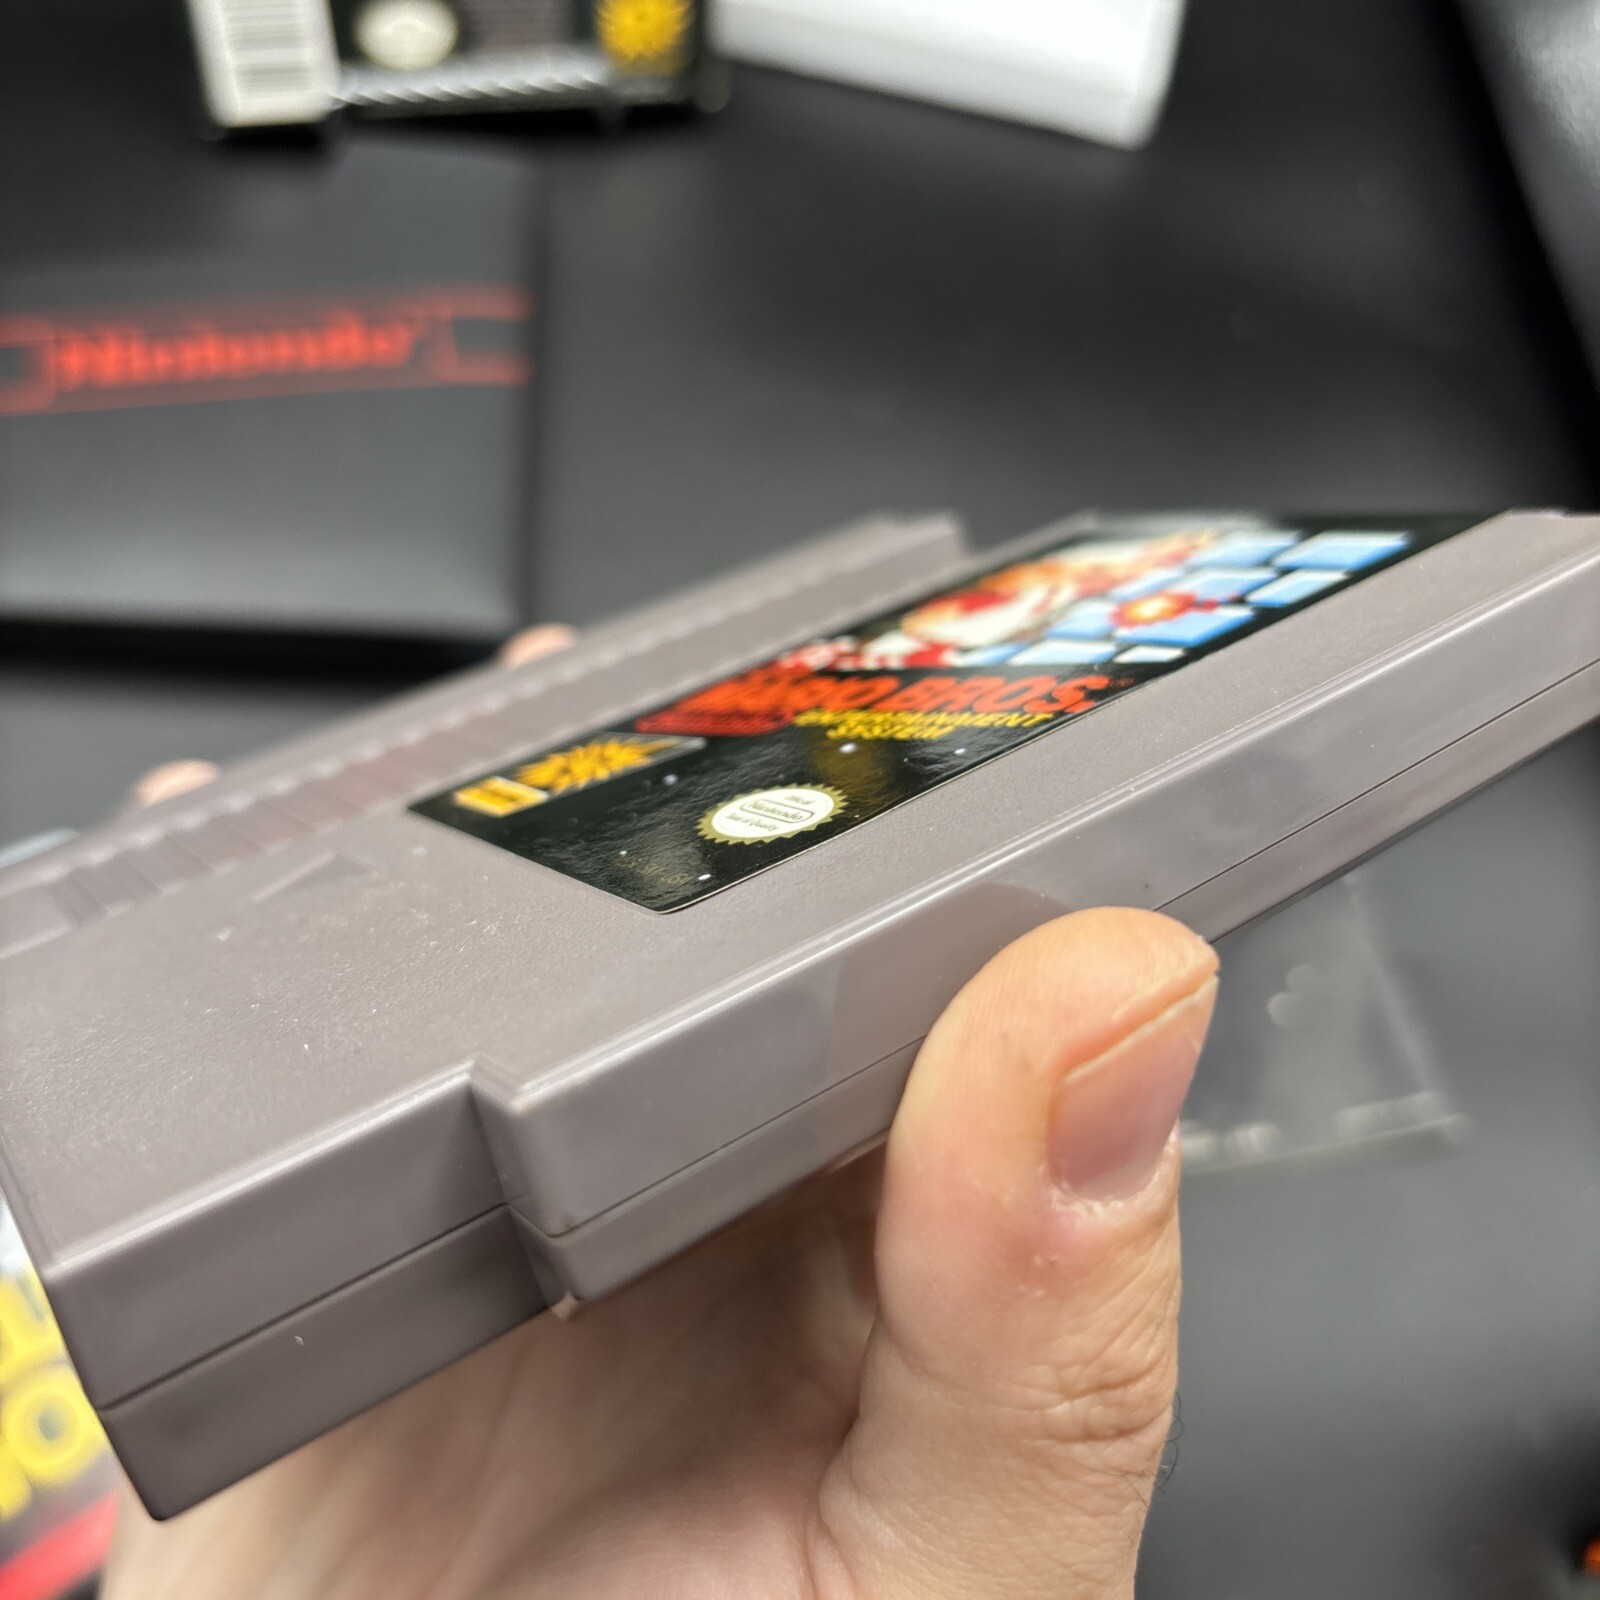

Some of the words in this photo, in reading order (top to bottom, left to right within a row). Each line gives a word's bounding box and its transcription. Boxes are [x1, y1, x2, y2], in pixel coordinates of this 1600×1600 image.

[795, 709, 1054, 728] RTAINMENT
[747, 800, 804, 821] Nintendo
[749, 818, 780, 832] Quality
